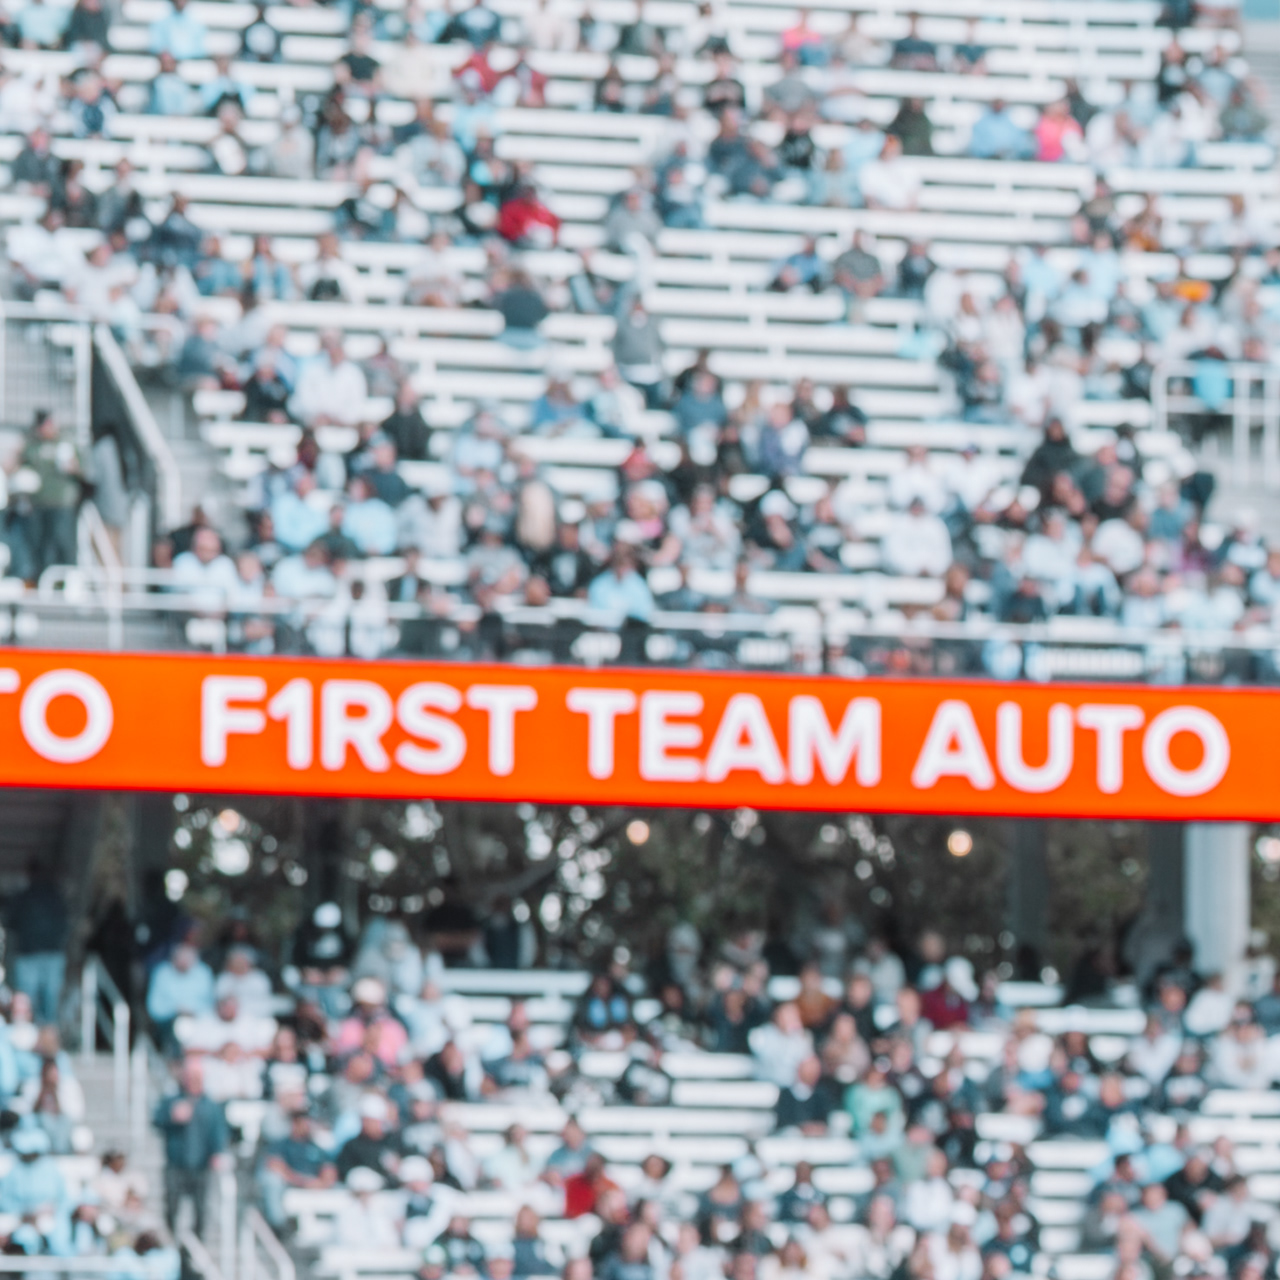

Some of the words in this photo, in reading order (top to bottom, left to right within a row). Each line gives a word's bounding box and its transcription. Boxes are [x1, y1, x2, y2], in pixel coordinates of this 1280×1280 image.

[0, 667, 114, 764] O
[201, 675, 538, 776] F1RST
[565, 687, 882, 787] TEAM
[911, 699, 1231, 797] AUTO
